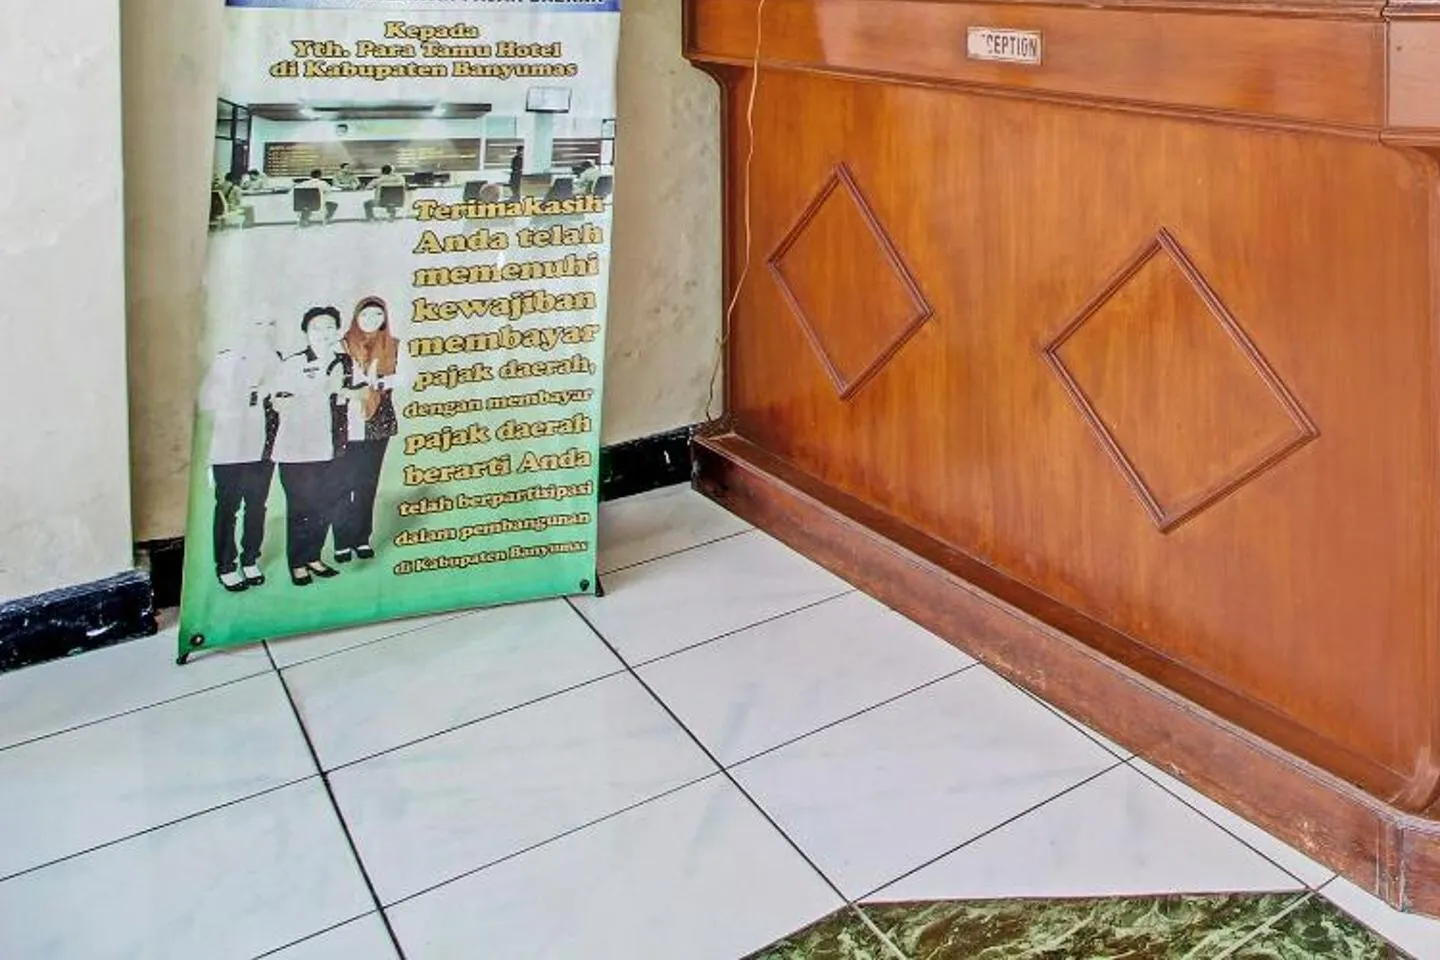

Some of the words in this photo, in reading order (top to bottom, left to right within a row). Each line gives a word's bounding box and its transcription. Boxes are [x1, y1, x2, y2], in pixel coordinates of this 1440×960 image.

[385, 20, 479, 41] Kepada
[291, 40, 351, 58] Yth.
[356, 40, 416, 58] Para
[421, 41, 492, 58] Tamu
[495, 40, 562, 58] Hotel
[269, 60, 299, 77] di
[303, 60, 448, 81] Kabupaten
[452, 61, 578, 81] Banyumas
[412, 194, 606, 221] Terimakasih
[412, 229, 509, 254] Anda
[516, 223, 604, 248] telah
[412, 252, 600, 287] memenuhi
[412, 290, 596, 323] kewajiban
[408, 324, 600, 357] membayar
[413, 363, 494, 390] pajak
[403, 399, 483, 419] dengan
[487, 388, 593, 411] membayar
[404, 423, 490, 455] pajak
[495, 413, 592, 441] daerah
[403, 455, 512, 486] berarti
[517, 447, 592, 473] Anda
[399, 496, 454, 517] telah
[457, 481, 594, 509] berpartisipasi
[394, 530, 456, 547] dalam
[458, 512, 590, 541] pembangunan
[394, 562, 413, 575] di
[415, 551, 508, 572] Kabupaten
[509, 541, 588, 560] Banyumas
